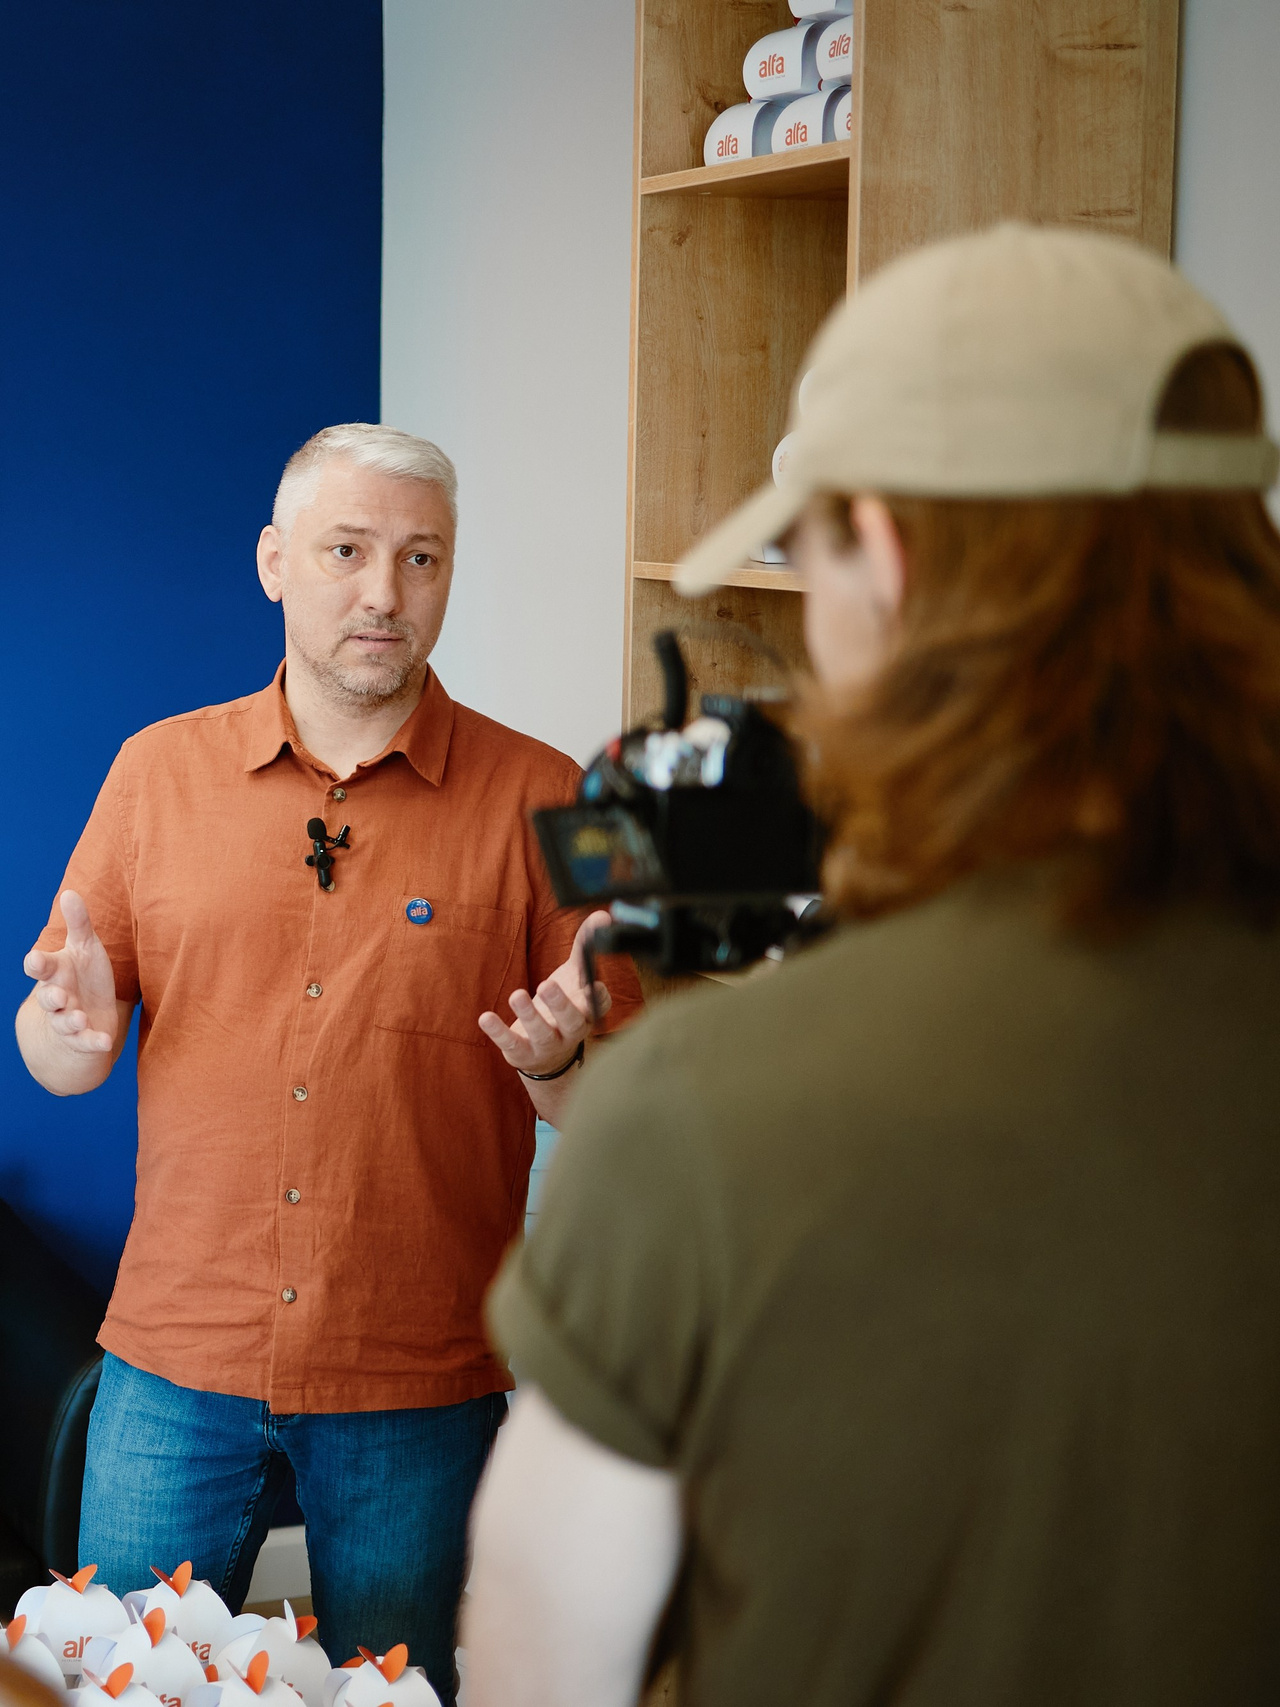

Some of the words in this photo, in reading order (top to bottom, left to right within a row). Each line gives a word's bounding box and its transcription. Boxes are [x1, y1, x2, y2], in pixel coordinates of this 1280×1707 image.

[828, 33, 851, 58] alfa
[759, 53, 785, 78] alfa
[717, 134, 738, 157] alfa
[785, 121, 808, 146] alfa
[410, 906, 428, 917] alfa
